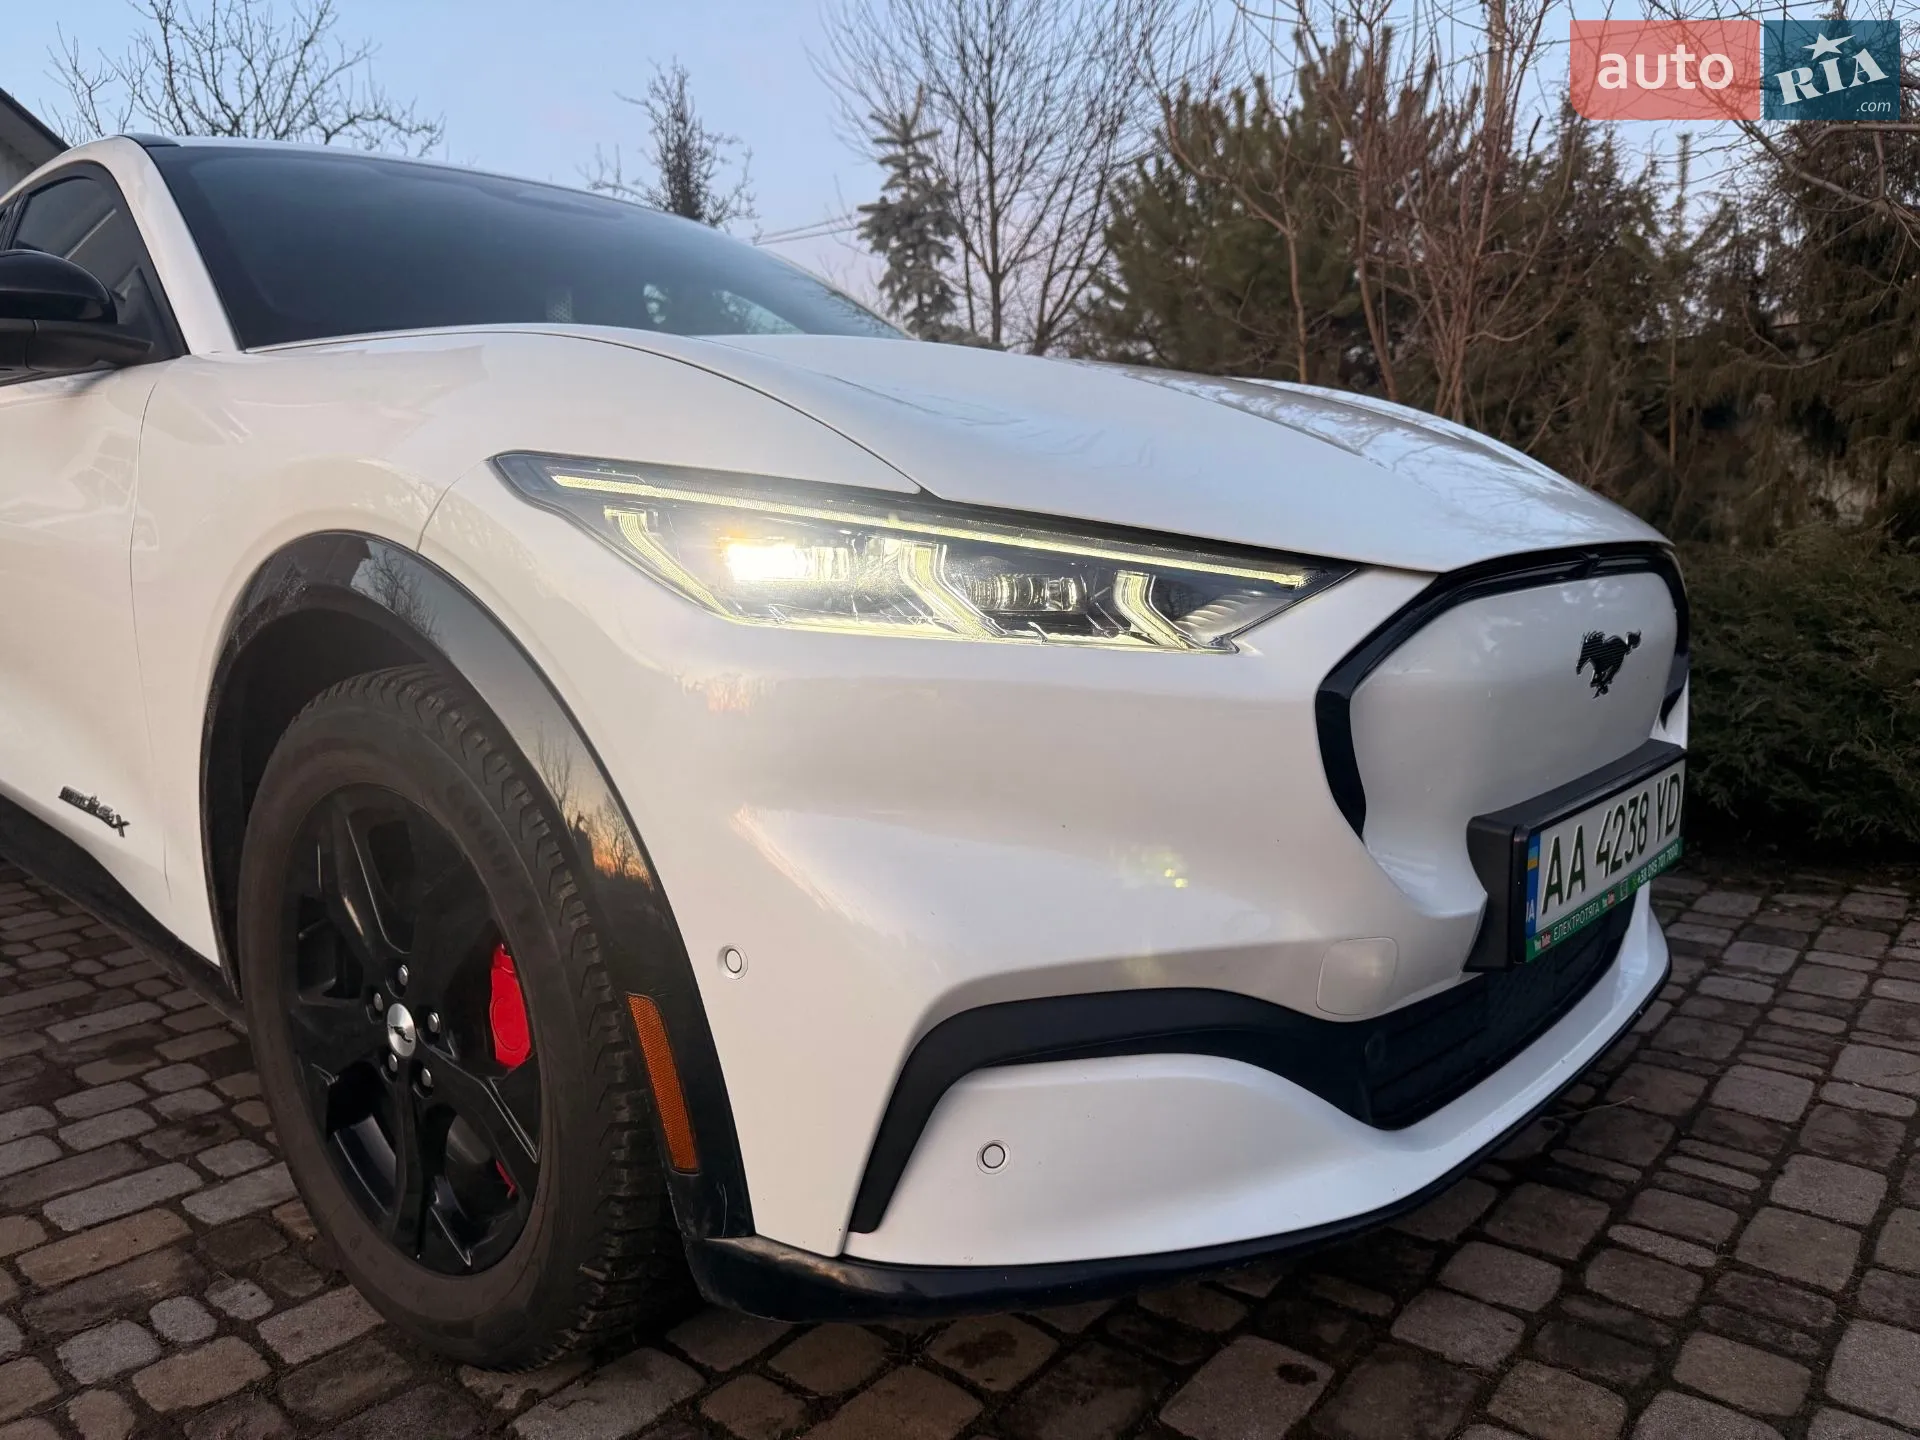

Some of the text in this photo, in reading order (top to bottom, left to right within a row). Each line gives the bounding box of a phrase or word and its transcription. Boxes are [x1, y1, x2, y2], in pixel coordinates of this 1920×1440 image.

[1542, 772, 1681, 915] AA 4238 YD
[1553, 901, 1600, 941] ЕЛЕКТРОТЯГА
